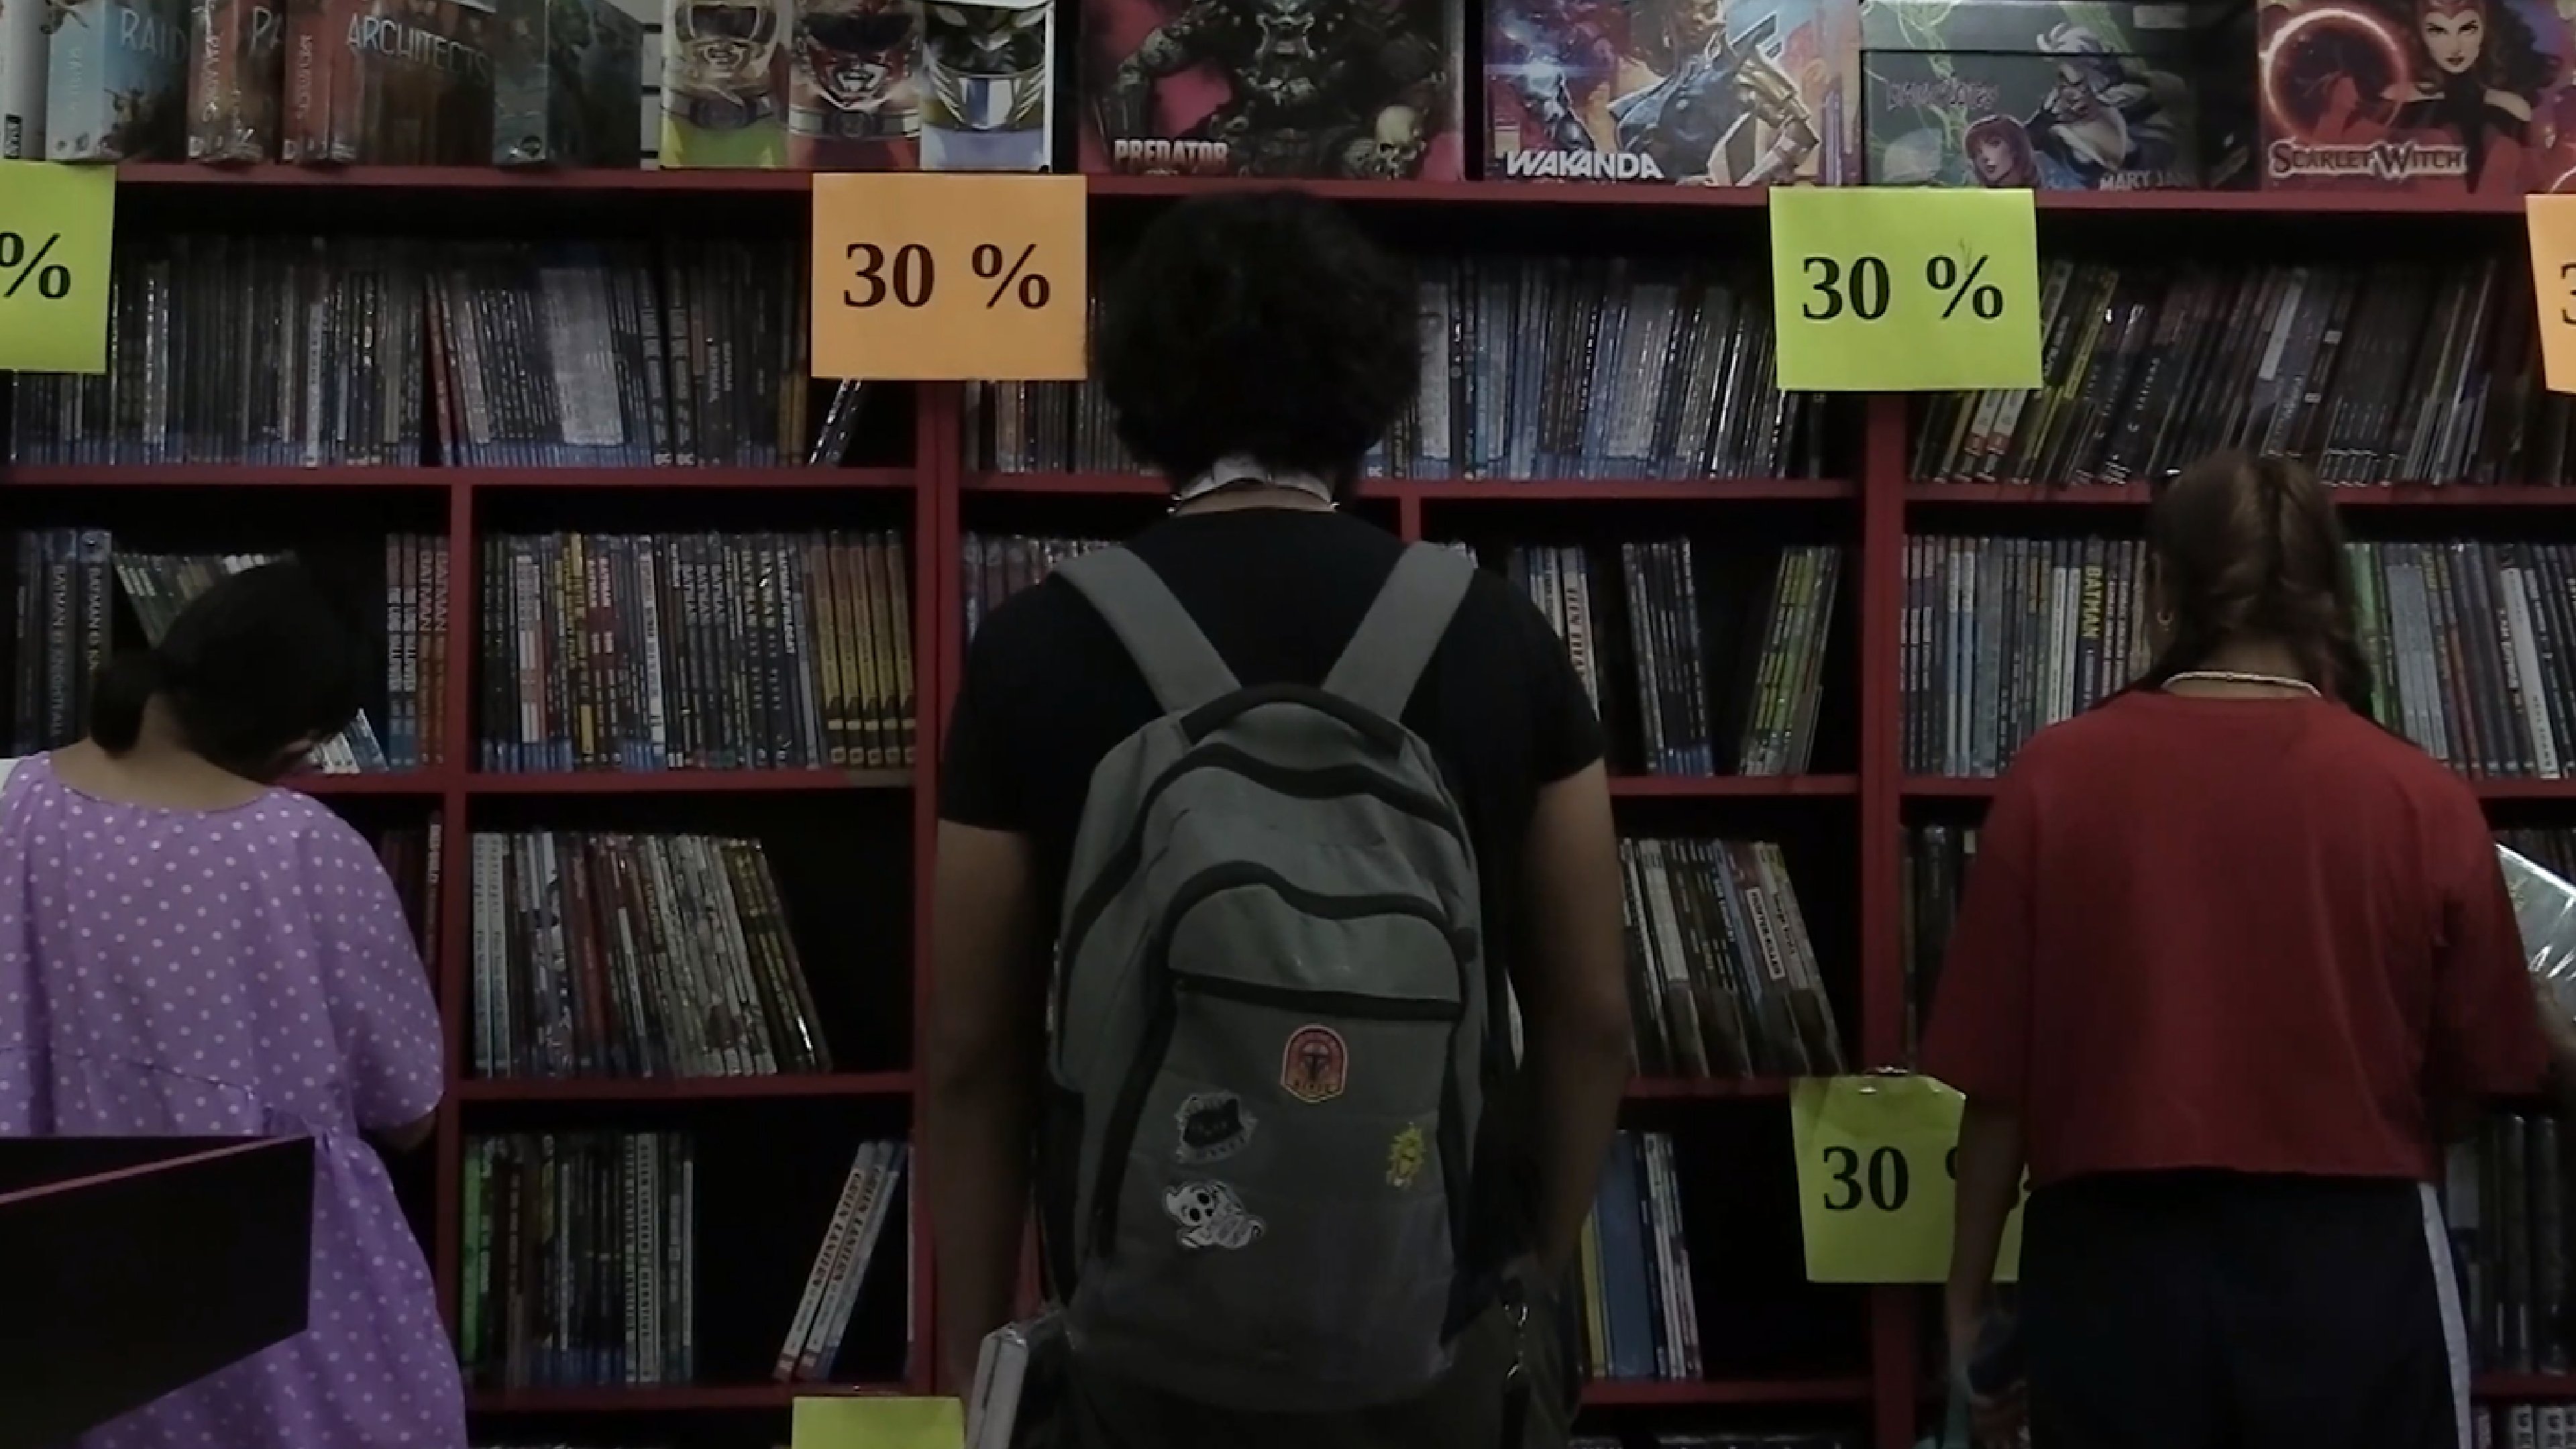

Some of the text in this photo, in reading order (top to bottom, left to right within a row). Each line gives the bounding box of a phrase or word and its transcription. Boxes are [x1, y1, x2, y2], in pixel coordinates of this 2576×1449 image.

[345, 11, 490, 85] ARCHITECTS
[1114, 138, 1229, 164] PREDATOR
[1507, 149, 1665, 179] WAKANDA
[2100, 169, 2151, 191] MARY
[2269, 138, 2469, 180] SCARLET WITCH
[843, 244, 1049, 309] 30 %
[1803, 255, 2003, 320] 30 %
[2081, 565, 2105, 639] BATMAN
[1823, 1146, 1909, 1212] 30
